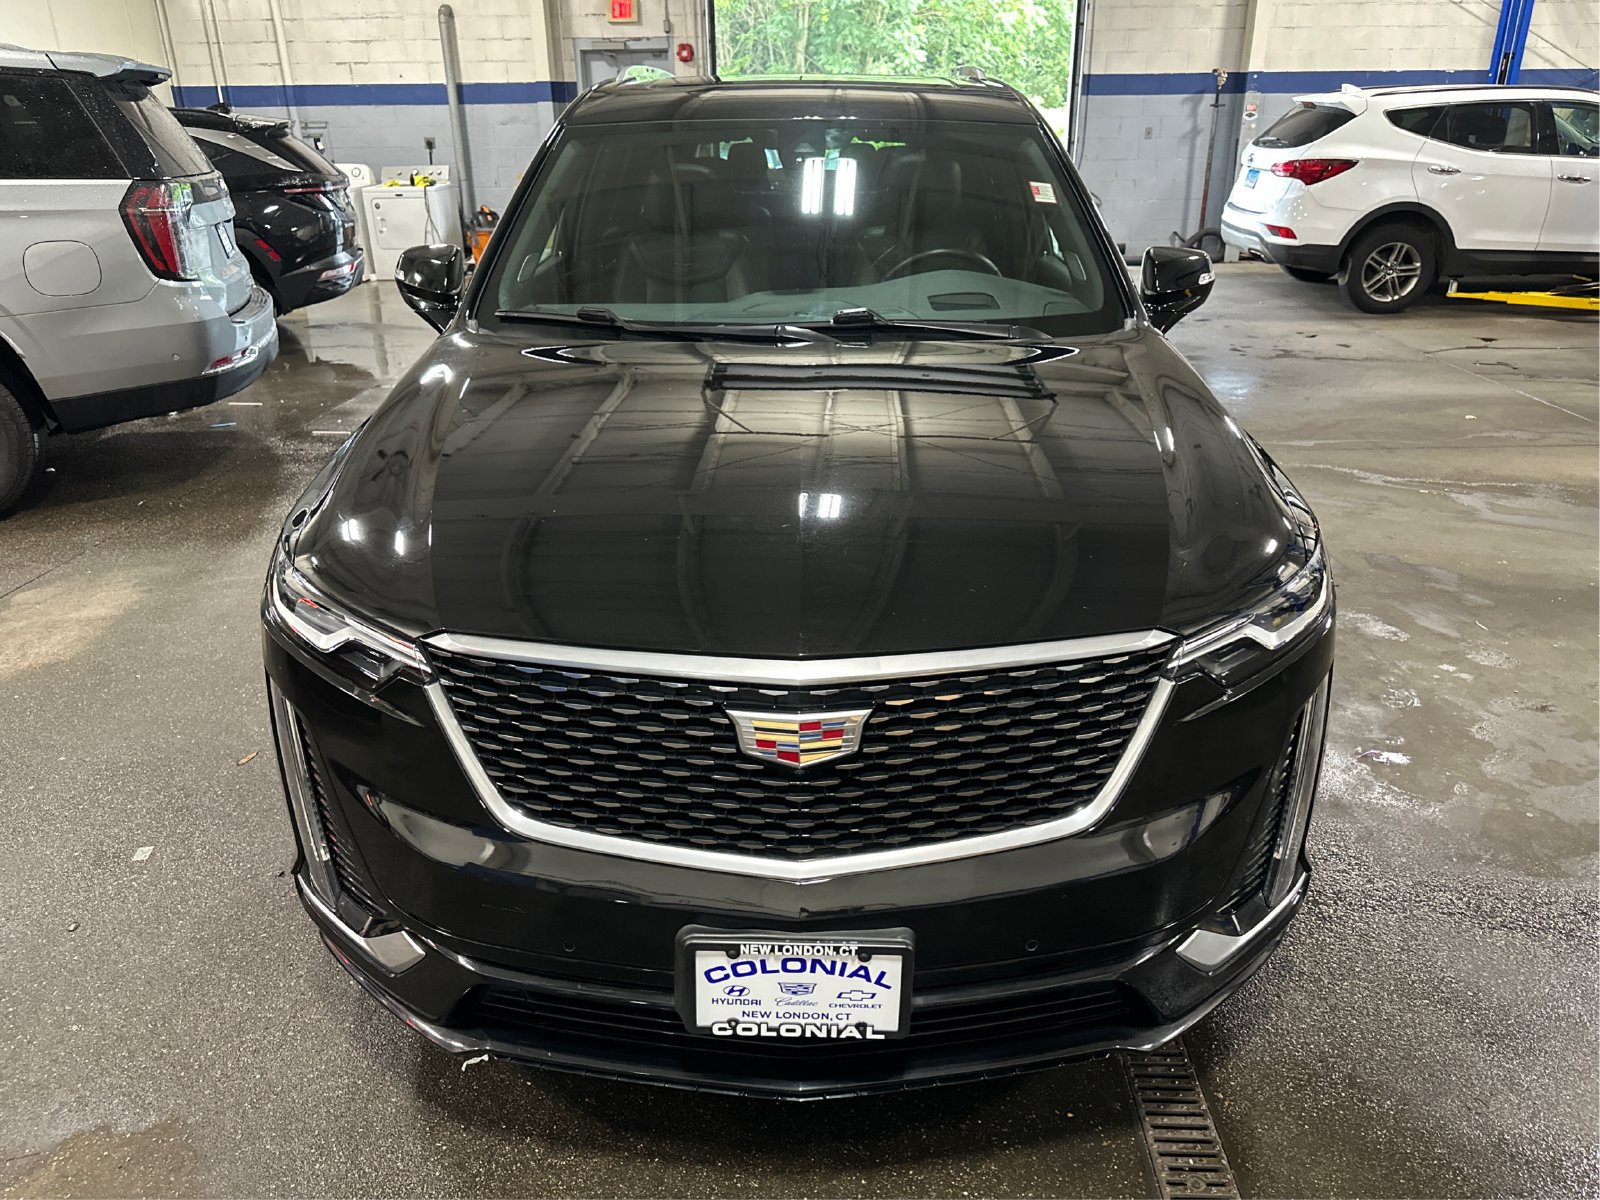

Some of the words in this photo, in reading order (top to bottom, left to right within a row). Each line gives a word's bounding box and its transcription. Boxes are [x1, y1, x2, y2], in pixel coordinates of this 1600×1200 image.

[740, 944, 774, 956] NEW
[775, 945, 836, 957] LONDON,
[839, 946, 858, 957] CT
[704, 958, 892, 990] COLONIAL
[712, 998, 761, 1006] HYUNDAI
[775, 997, 818, 1007] Cadillac
[742, 1010, 772, 1019] NEW
[776, 1011, 833, 1021] LONDON,
[836, 1013, 852, 1021] CT
[712, 1022, 885, 1040] COLONIAL
